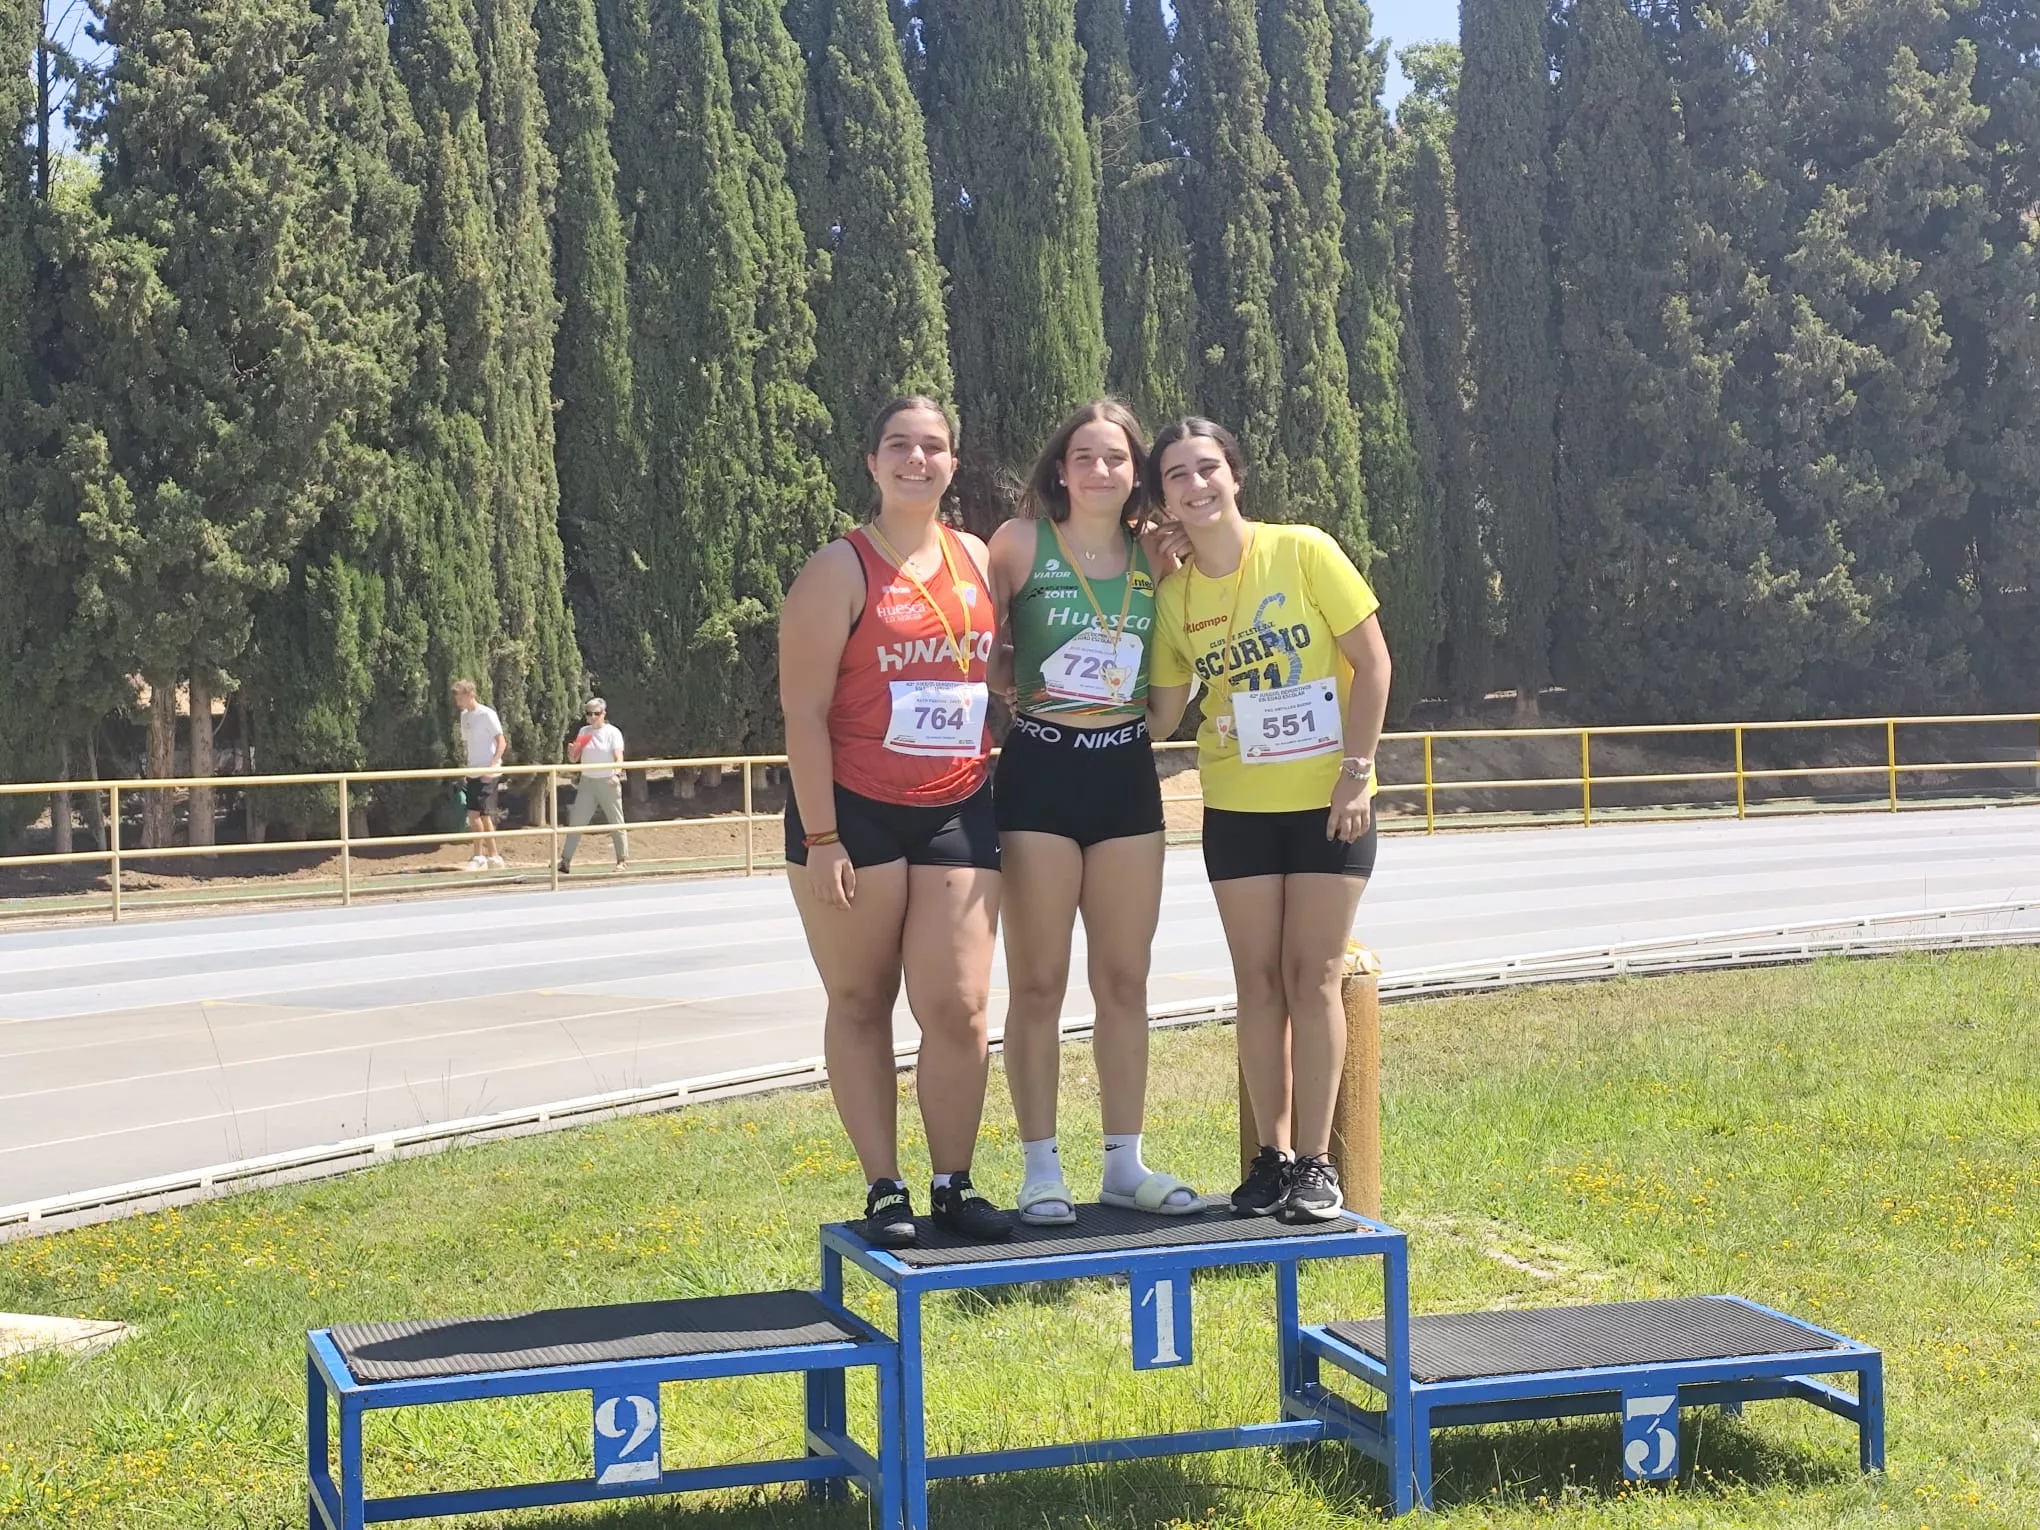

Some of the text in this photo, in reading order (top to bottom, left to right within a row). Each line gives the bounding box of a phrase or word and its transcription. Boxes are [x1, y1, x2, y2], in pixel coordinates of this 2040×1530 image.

[1034, 571, 1072, 579] VIATOR
[1047, 607, 1152, 631] Huesca
[1195, 623, 1311, 680] SCORPIO
[1228, 661, 1282, 691] 71
[915, 706, 964, 730] 764
[1262, 710, 1316, 739] 551
[1015, 718, 1062, 743] PRO
[1074, 726, 1134, 749] NIKE
[872, 1194, 906, 1214] NIKE
[1140, 1279, 1182, 1363] 1
[595, 1395, 660, 1485] 2
[1624, 1394, 1677, 1475] 3
